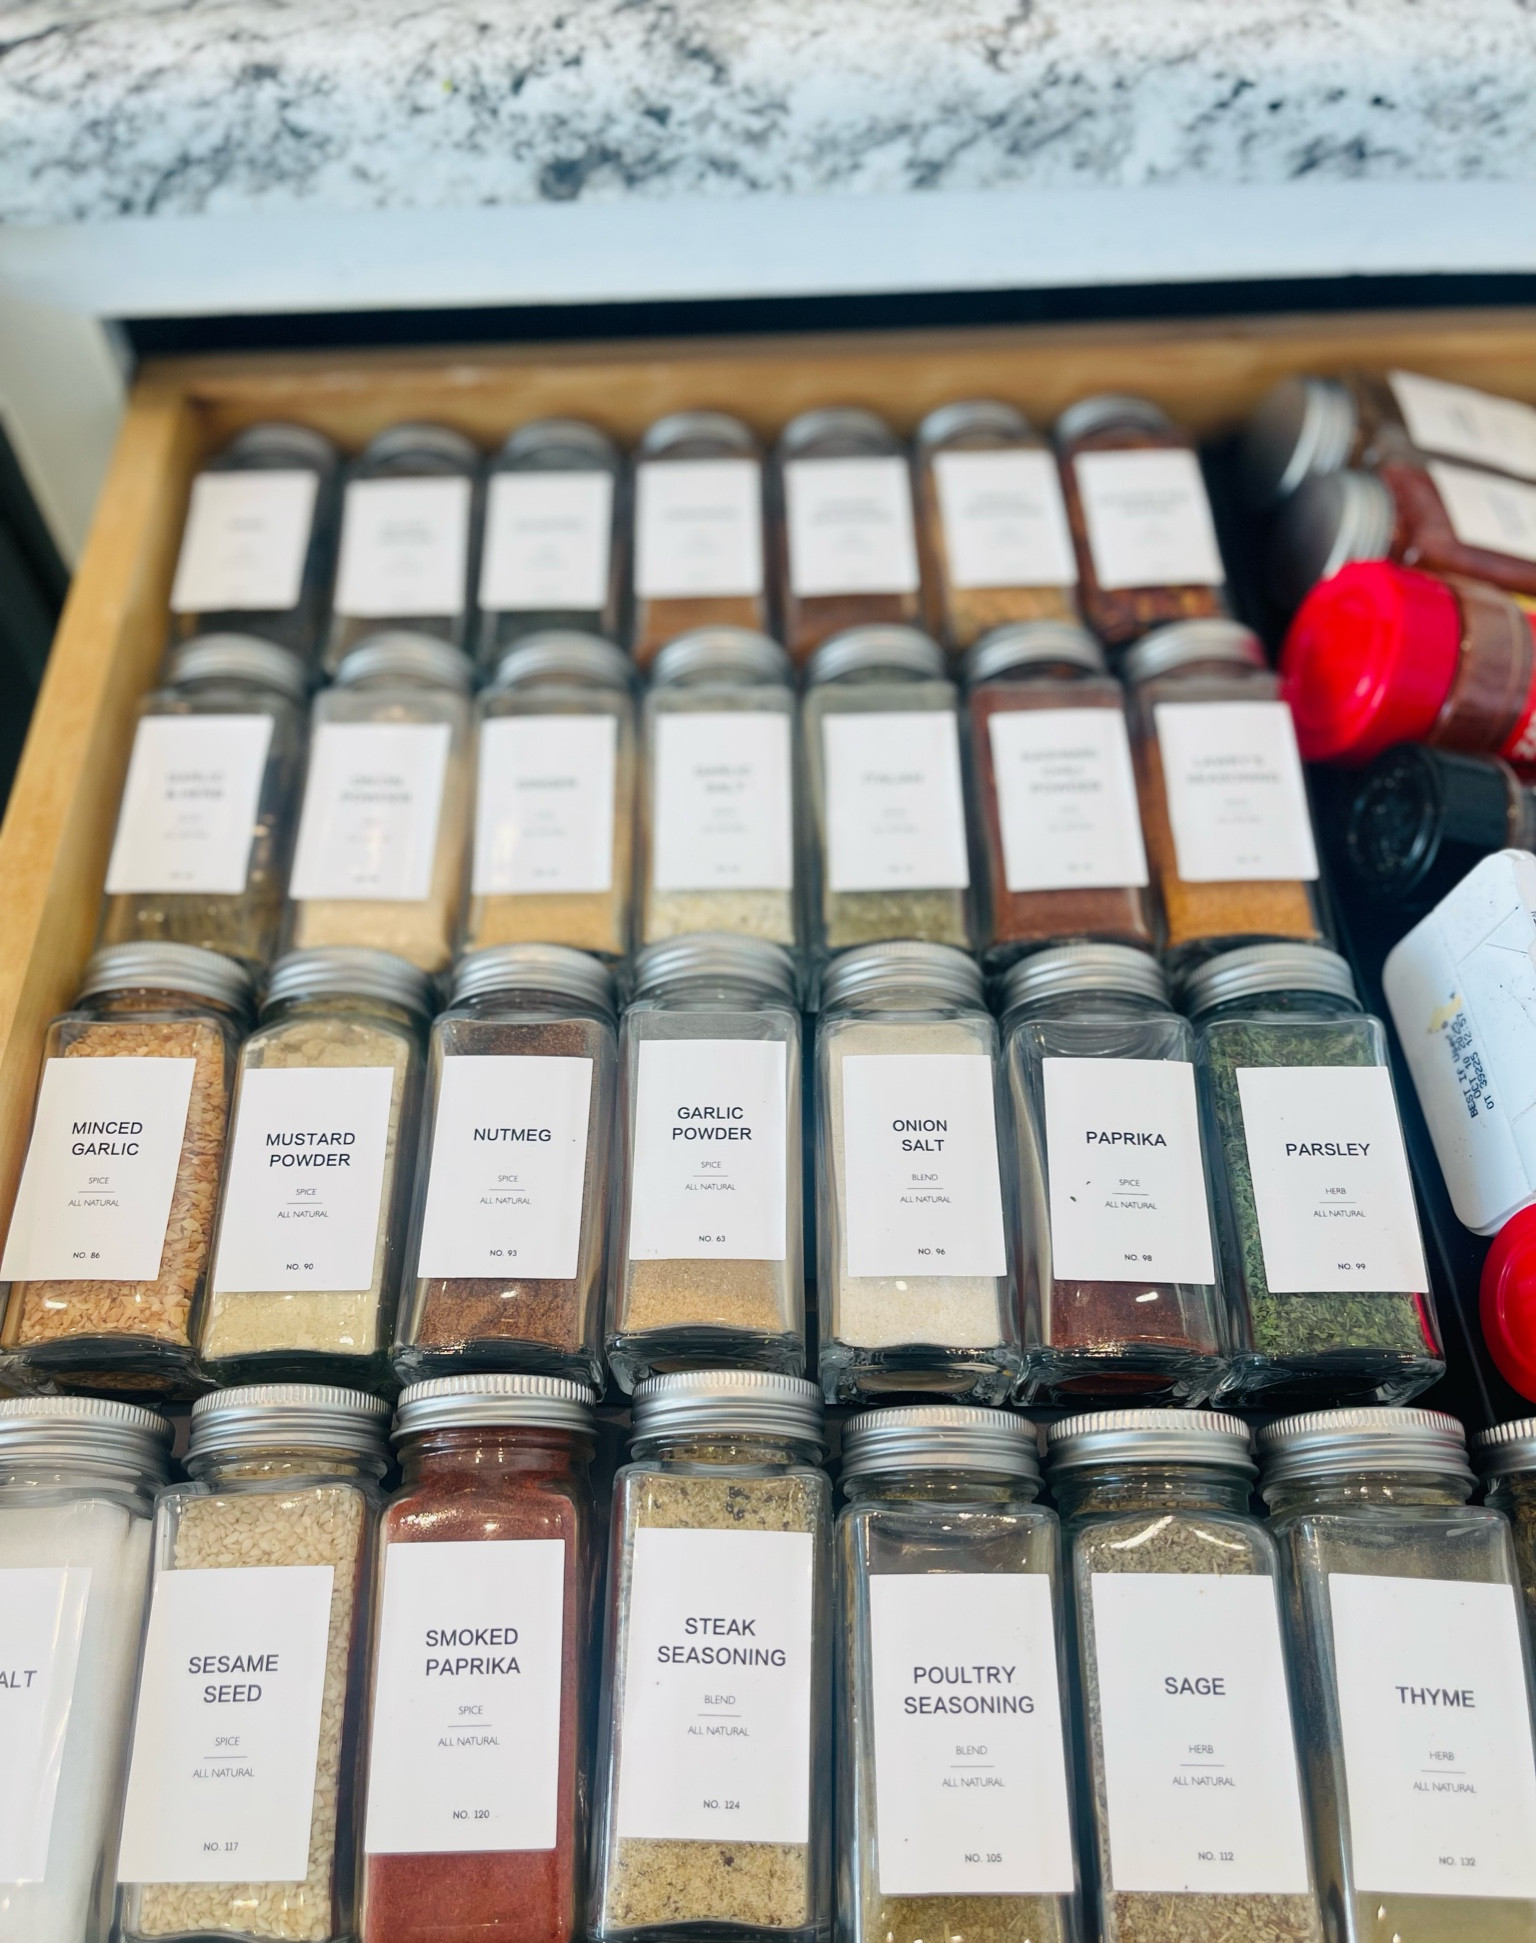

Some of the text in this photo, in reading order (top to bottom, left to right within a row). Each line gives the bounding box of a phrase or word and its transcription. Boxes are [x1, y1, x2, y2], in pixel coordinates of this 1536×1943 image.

[1462, 1056, 1474, 1070] 10
[1468, 1052, 1489, 1088] 39225
[1468, 1077, 1482, 1099] OCT
[1462, 1089, 1480, 1118] BEST
[677, 1107, 743, 1119] GARLIC
[72, 1121, 143, 1135] MINCED
[892, 1119, 947, 1132] ONION
[265, 1132, 356, 1146] MUSTARD
[473, 1128, 552, 1142] NUTMEG
[672, 1127, 752, 1140] POWDER
[1086, 1132, 1167, 1147] PAPRIKA
[71, 1142, 140, 1156] GARLIC
[902, 1139, 944, 1152] SALT
[1285, 1143, 1370, 1156] PARSLEY
[269, 1153, 351, 1167] POWDER
[88, 1177, 109, 1185] SPICE
[1118, 1179, 1140, 1187] SPICE
[700, 1183, 736, 1191] NATURAL
[1325, 1187, 1346, 1195] HERB
[68, 1199, 120, 1207] ALL NATURAL
[500, 1197, 532, 1205] NATURAL
[1121, 1201, 1157, 1209] NATURAL
[685, 1618, 756, 1636] STEAK
[426, 1629, 518, 1647] SMOKED
[657, 1646, 787, 1666] SEASONING
[188, 1654, 279, 1674] SESAME
[425, 1657, 521, 1676] PAPRIKA
[913, 1666, 1017, 1684] POULTRY
[1164, 1677, 1225, 1696] SAGE
[203, 1685, 262, 1703] SEED
[1395, 1687, 1475, 1708] THYME
[704, 1695, 736, 1705] BLEND
[904, 1696, 1034, 1714] SEASONING
[458, 1706, 483, 1715] SPICE
[688, 1726, 749, 1737] ALL NATURAL
[215, 1737, 240, 1746] SPICE
[438, 1736, 500, 1747] ALL NATURAL
[956, 1746, 987, 1755] BLEND
[1189, 1745, 1214, 1754] HERB
[1429, 1751, 1454, 1761] HERB
[193, 1768, 255, 1778] ALL NATURAL
[942, 1778, 1005, 1787] ALL NATURAL
[1172, 1777, 1235, 1786] ALL NATURAL
[1413, 1782, 1476, 1793] ALL NATURAL
[703, 1800, 740, 1810] NO. 124
[453, 1810, 490, 1819] NO. 120
[203, 1842, 239, 1851] NO. 117
[964, 1853, 1002, 1862] NO. 105
[1198, 1852, 1234, 1861] NO. 112
[1439, 1857, 1456, 1866] NO.
